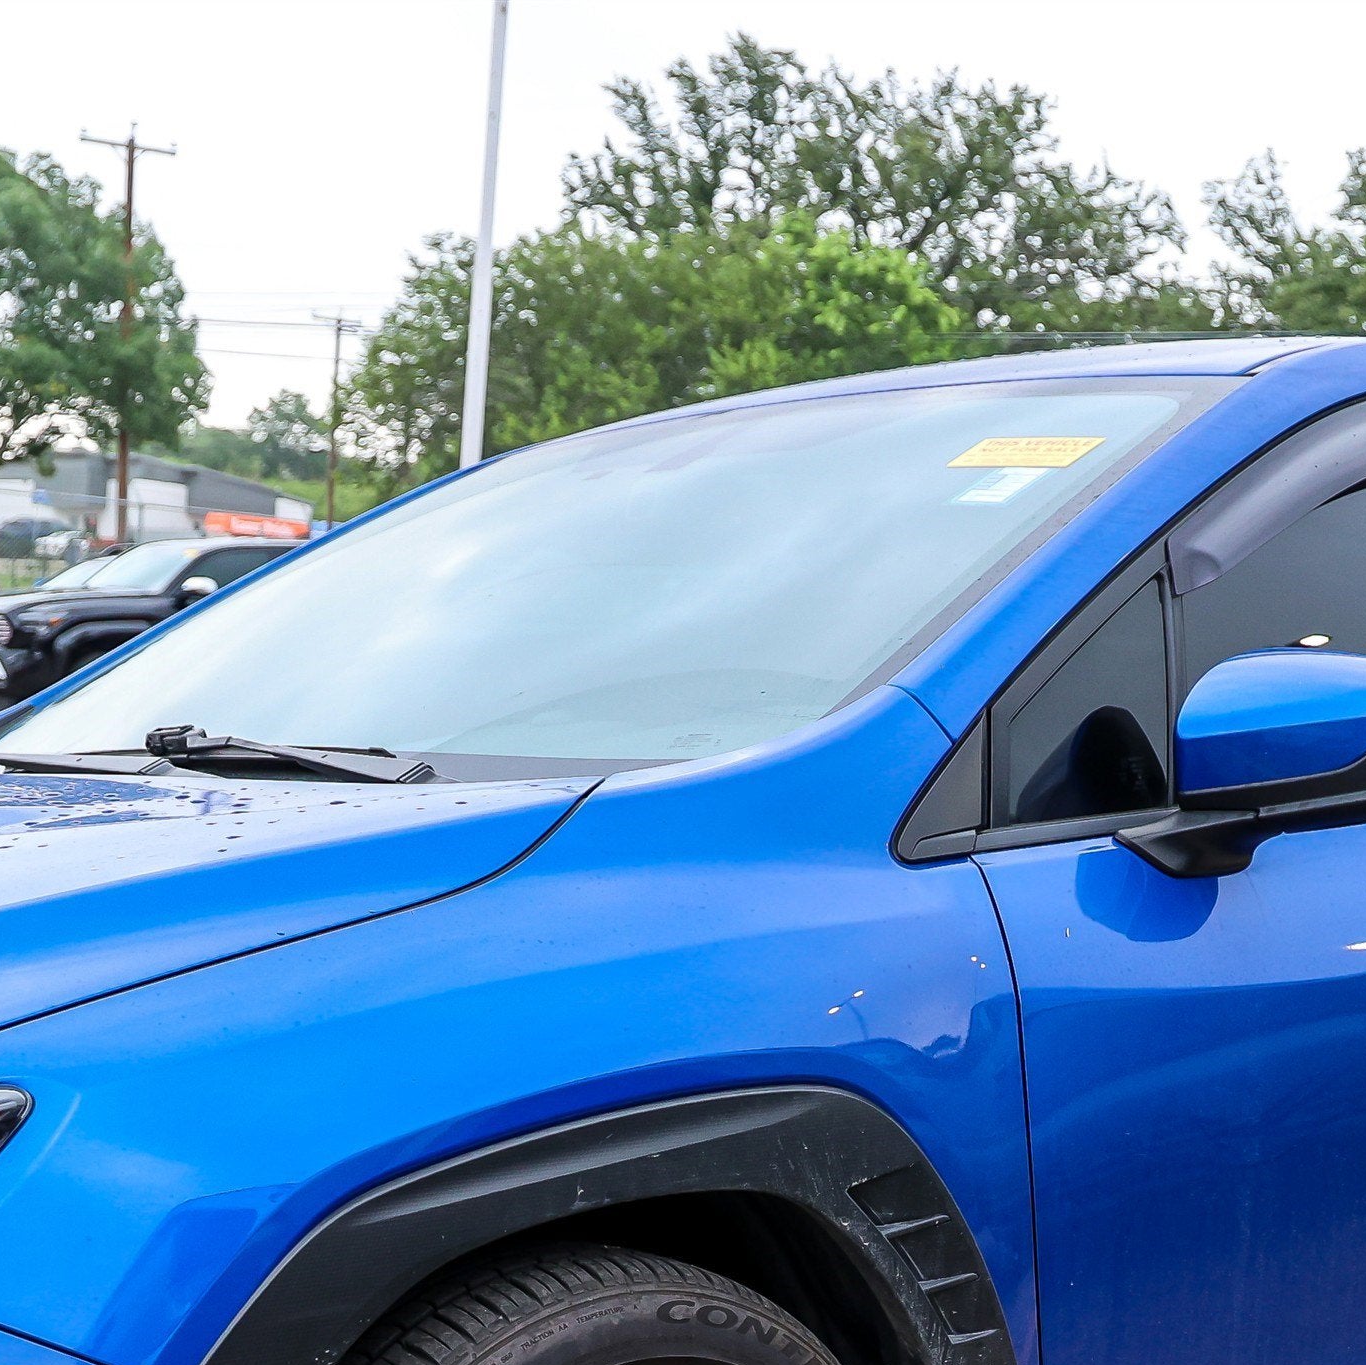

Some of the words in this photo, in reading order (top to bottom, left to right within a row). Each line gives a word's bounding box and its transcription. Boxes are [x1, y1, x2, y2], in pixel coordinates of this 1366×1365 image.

[1025, 438, 1095, 447] VEHICLE
[520, 1328, 555, 1351] TRACTION
[557, 1322, 569, 1334] AA
[575, 1305, 627, 1325] TEMPERATURE
